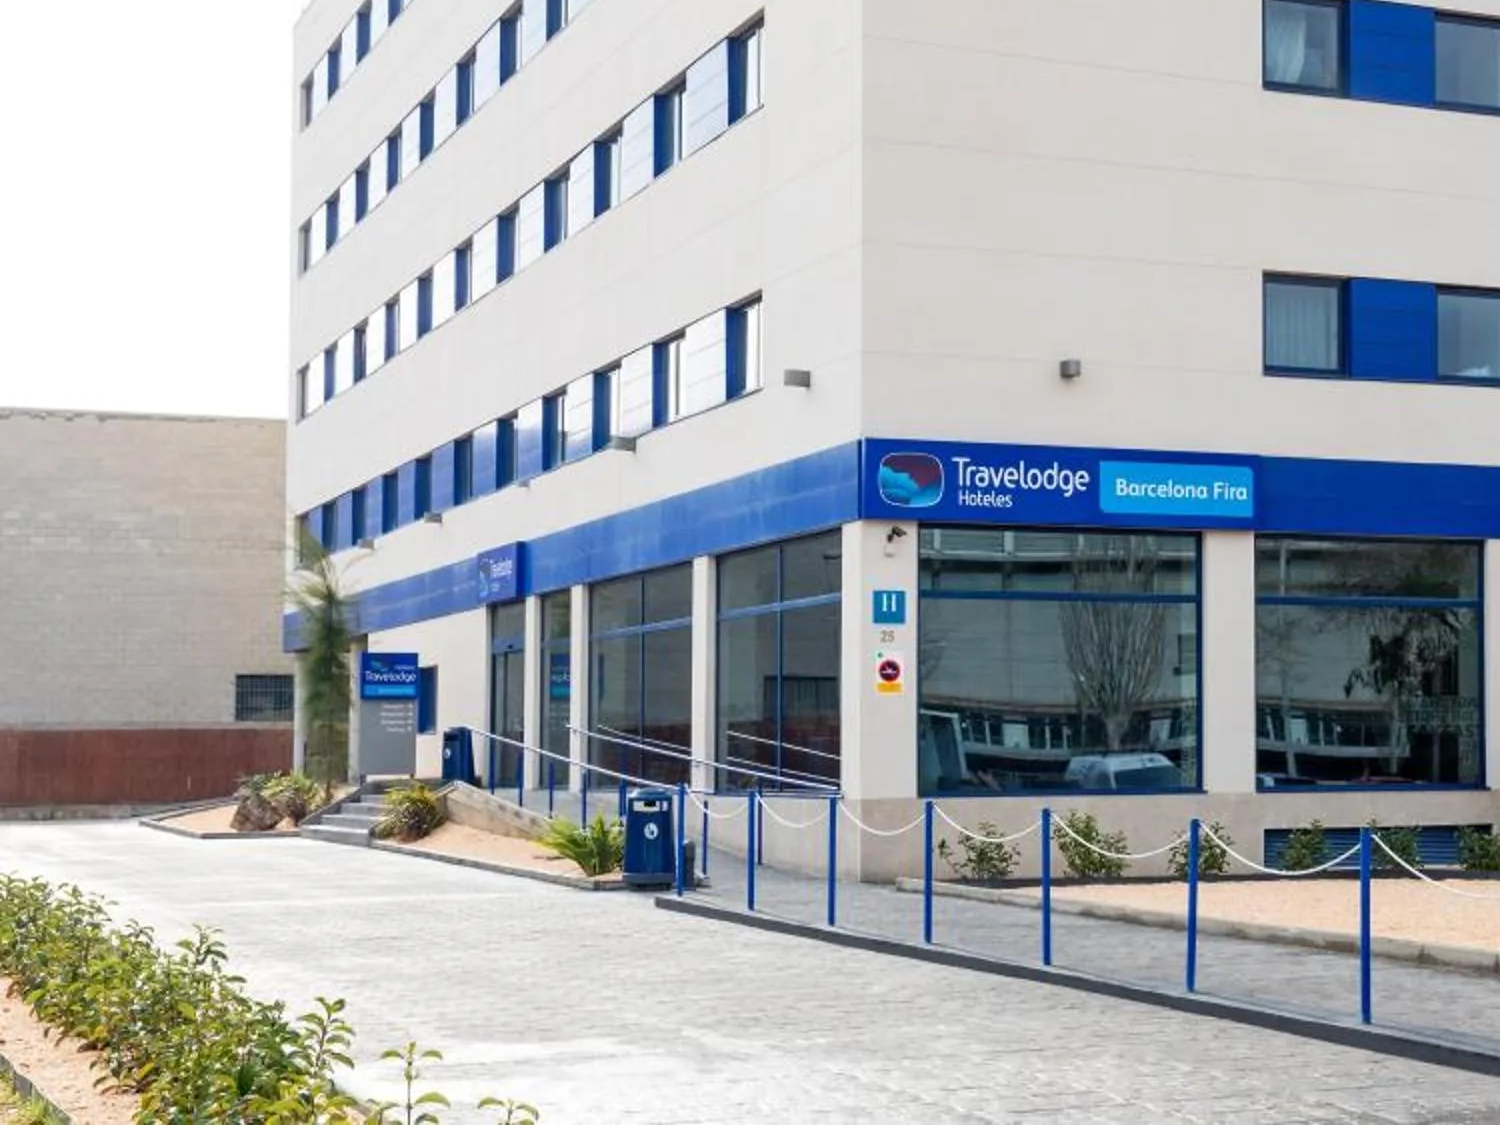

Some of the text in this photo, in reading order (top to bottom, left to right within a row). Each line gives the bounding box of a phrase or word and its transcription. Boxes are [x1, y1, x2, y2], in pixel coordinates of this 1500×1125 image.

[951, 456, 1090, 498] Travelodge
[1115, 477, 1248, 501] Barcelona Fira
[958, 489, 1013, 508] Hoteles
